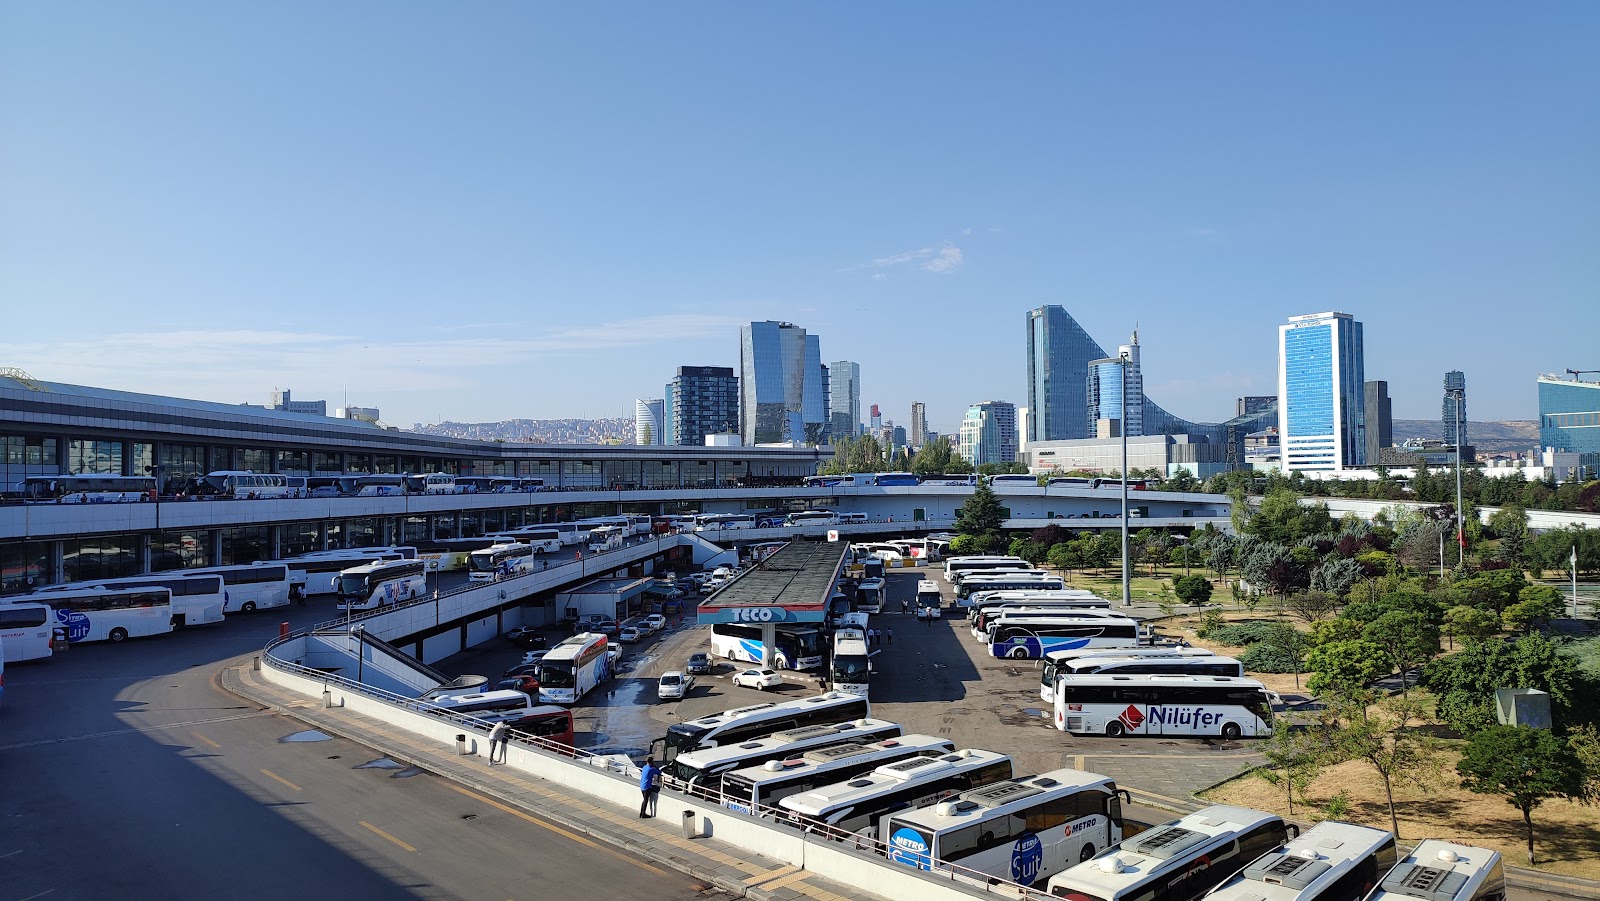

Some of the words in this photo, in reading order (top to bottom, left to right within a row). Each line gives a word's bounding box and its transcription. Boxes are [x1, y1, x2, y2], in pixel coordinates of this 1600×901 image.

[731, 608, 773, 622] TECO
[1149, 707, 1223, 729] Nilüfer
[1071, 817, 1097, 834] METRO
[896, 835, 925, 851] METRO
[1012, 855, 1041, 881] Suit
